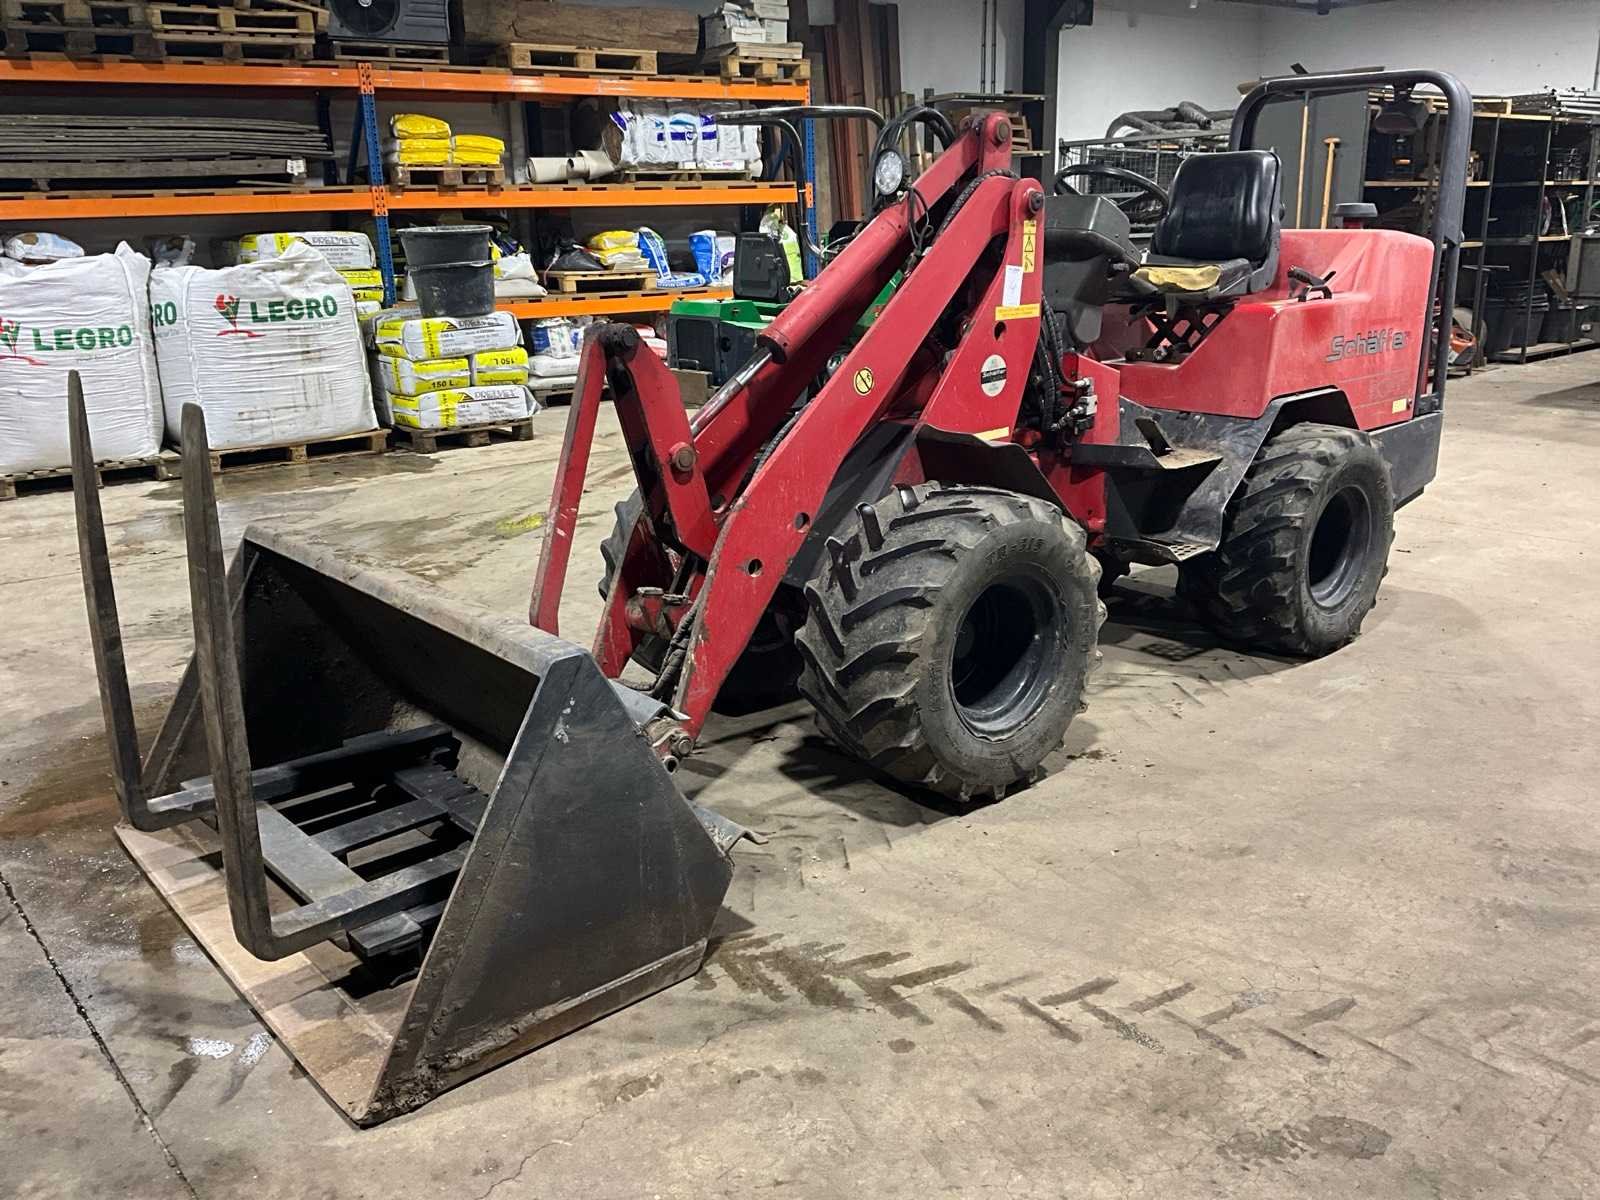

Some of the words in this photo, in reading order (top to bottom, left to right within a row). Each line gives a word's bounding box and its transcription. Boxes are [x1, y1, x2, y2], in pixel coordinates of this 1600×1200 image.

[250, 295, 338, 323] LEGRO
[31, 324, 133, 351] LEGRO
[501, 357, 515, 365] 150
[431, 380, 447, 388] 150
